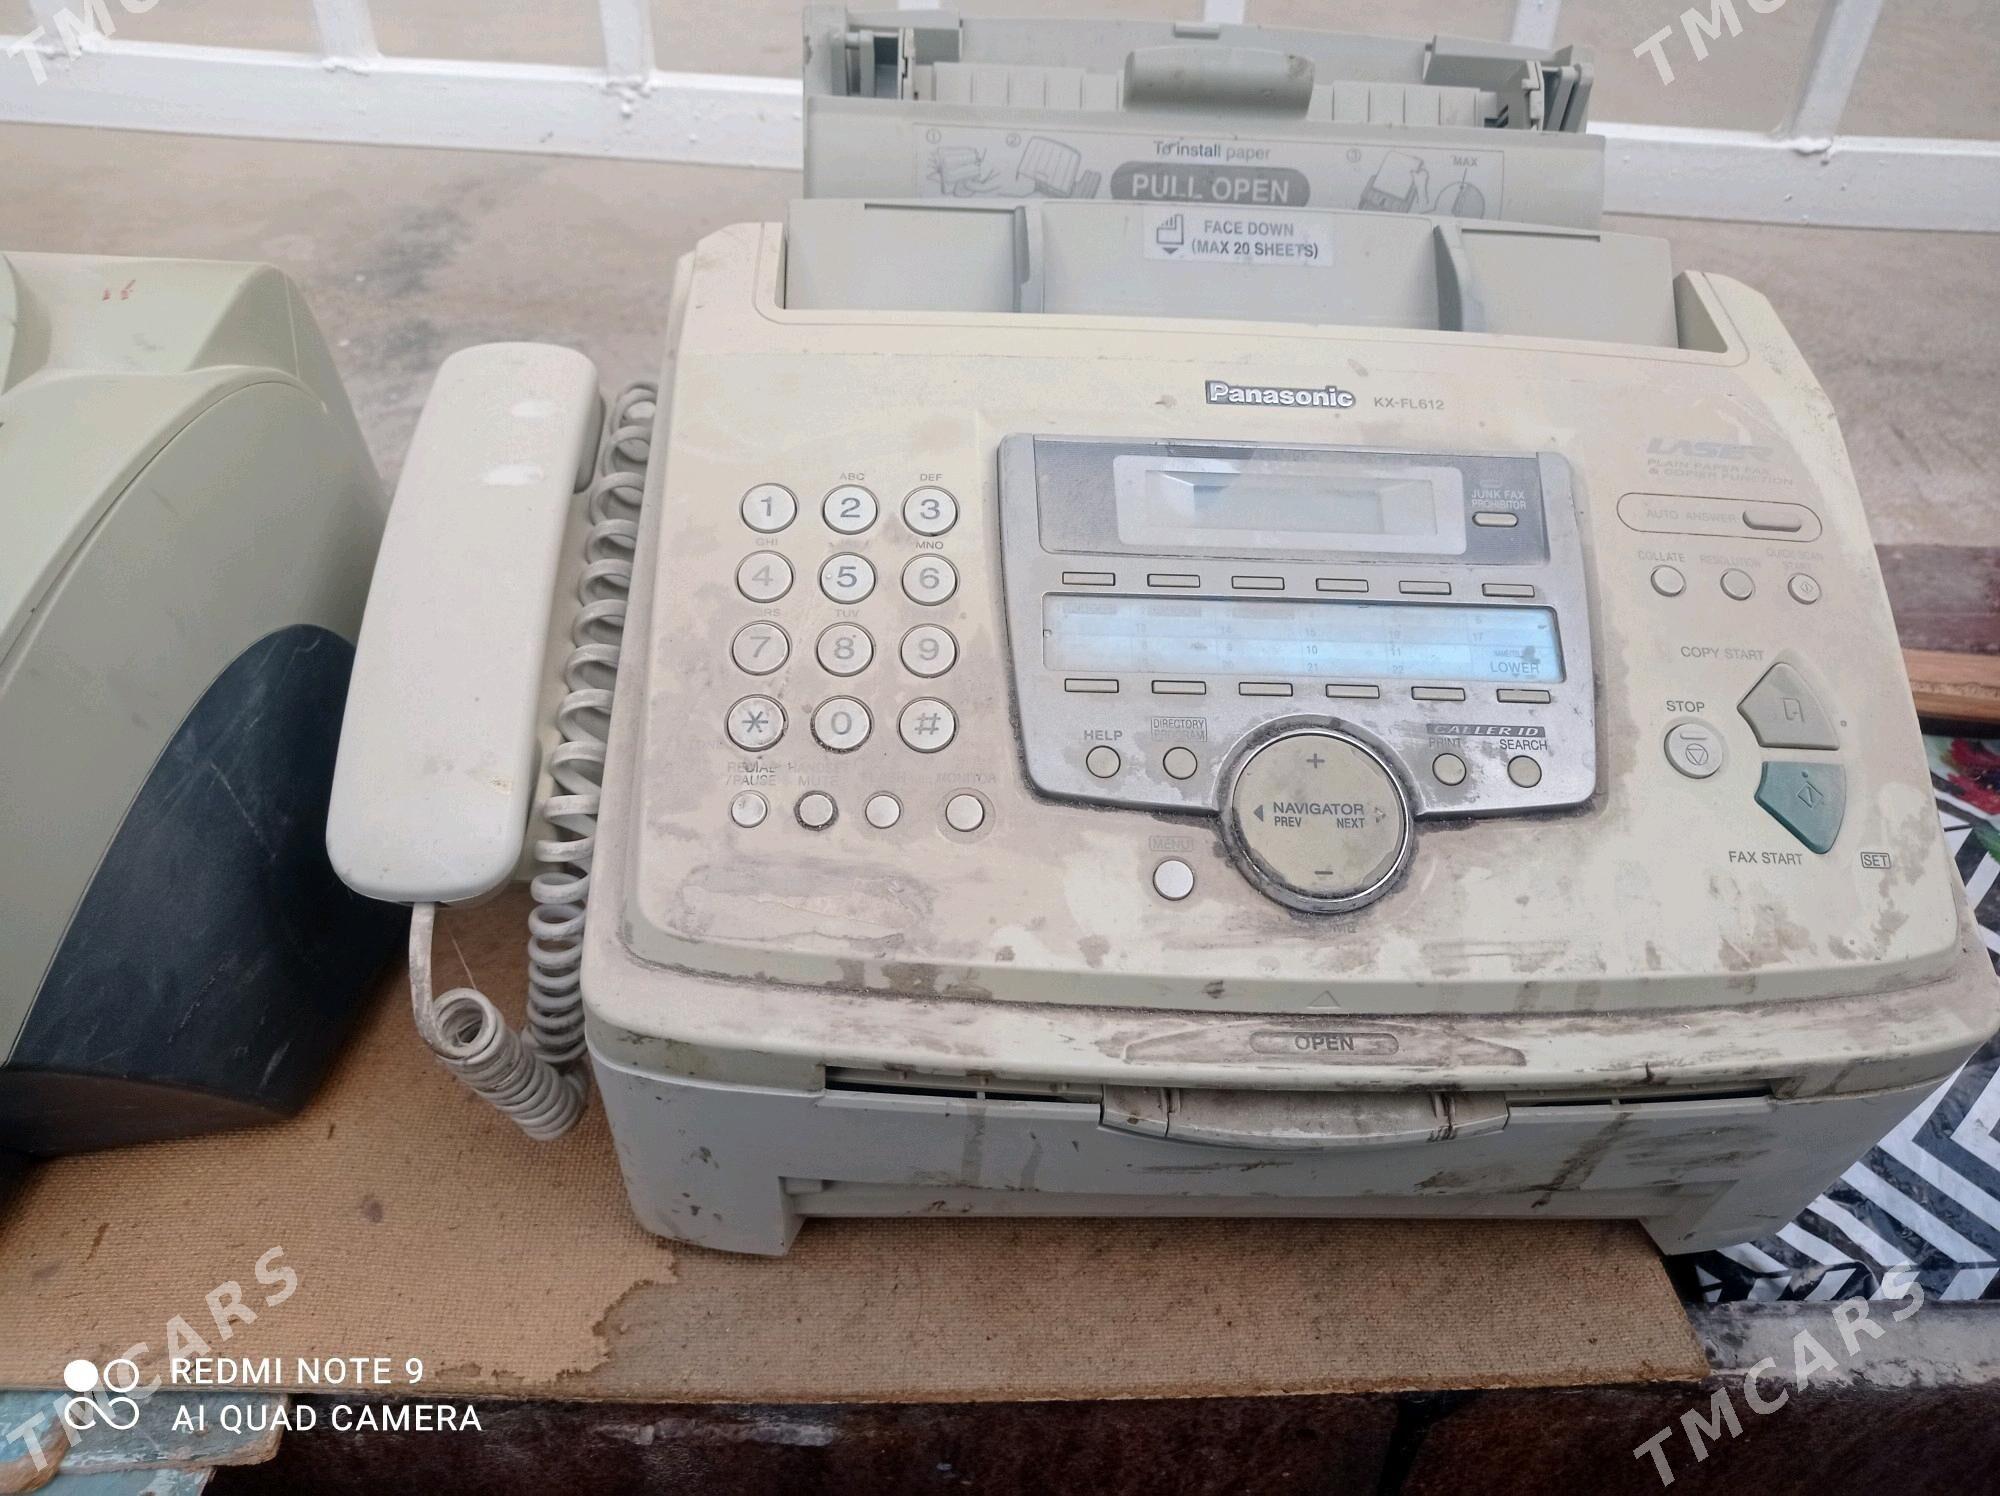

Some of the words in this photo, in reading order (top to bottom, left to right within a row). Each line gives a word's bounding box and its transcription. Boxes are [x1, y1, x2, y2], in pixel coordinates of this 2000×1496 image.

[1153, 139, 1173, 156] To
[1175, 141, 1221, 159] install
[1226, 145, 1270, 162] paper
[1451, 155, 1478, 168] MAX
[1131, 174, 1199, 200] PULL
[1212, 176, 1289, 203] OPEN
[1204, 220, 1250, 236] FACE
[1254, 222, 1294, 238] DOWN
[1191, 240, 1230, 256] (MAX
[1233, 241, 1250, 256] 20
[1254, 242, 1318, 260] SHEETS)
[1205, 380, 1356, 410] Panasonic
[1373, 397, 1446, 411] KX-FL612
[839, 472, 865, 482] ABC
[919, 473, 943, 482] DEF
[1471, 489, 1501, 499] JUNK
[1503, 490, 1526, 500] FAX
[760, 496, 772, 517] 1
[839, 497, 862, 519] 2
[919, 498, 942, 520] 3
[755, 537, 778, 547] GHI
[915, 541, 944, 551] MNO
[1637, 550, 1686, 563] COLLATE
[751, 564, 774, 587] 4
[836, 566, 859, 588] 5
[918, 567, 941, 590] 6
[835, 608, 860, 618] TUV
[749, 635, 772, 659] 7
[833, 637, 856, 660] 8
[917, 638, 941, 661] 9
[1306, 644, 1318, 655] 10
[1680, 646, 1720, 659] COPY
[1723, 649, 1764, 661] START
[1489, 661, 1540, 674] LOWER
[1665, 700, 1706, 713] STOP
[830, 711, 853, 735] 0
[913, 712, 942, 736] #
[1153, 718, 1205, 730] DIRECTORY
[1083, 730, 1123, 741] HELP
[1434, 725, 1512, 736] CALLER
[1517, 727, 1539, 737] ID
[1428, 737, 1462, 748] PRINT
[1499, 739, 1548, 751] SEARCH
[1273, 801, 1365, 817] NAVIGATOR
[1274, 816, 1302, 829] PREV
[1337, 817, 1365, 830] NEXT
[1152, 838, 1190, 850] MENU
[1729, 850, 1757, 865] FAX
[1761, 851, 1803, 866] START
[1863, 854, 1888, 868] SET
[1294, 1033, 1355, 1051] OPEN
